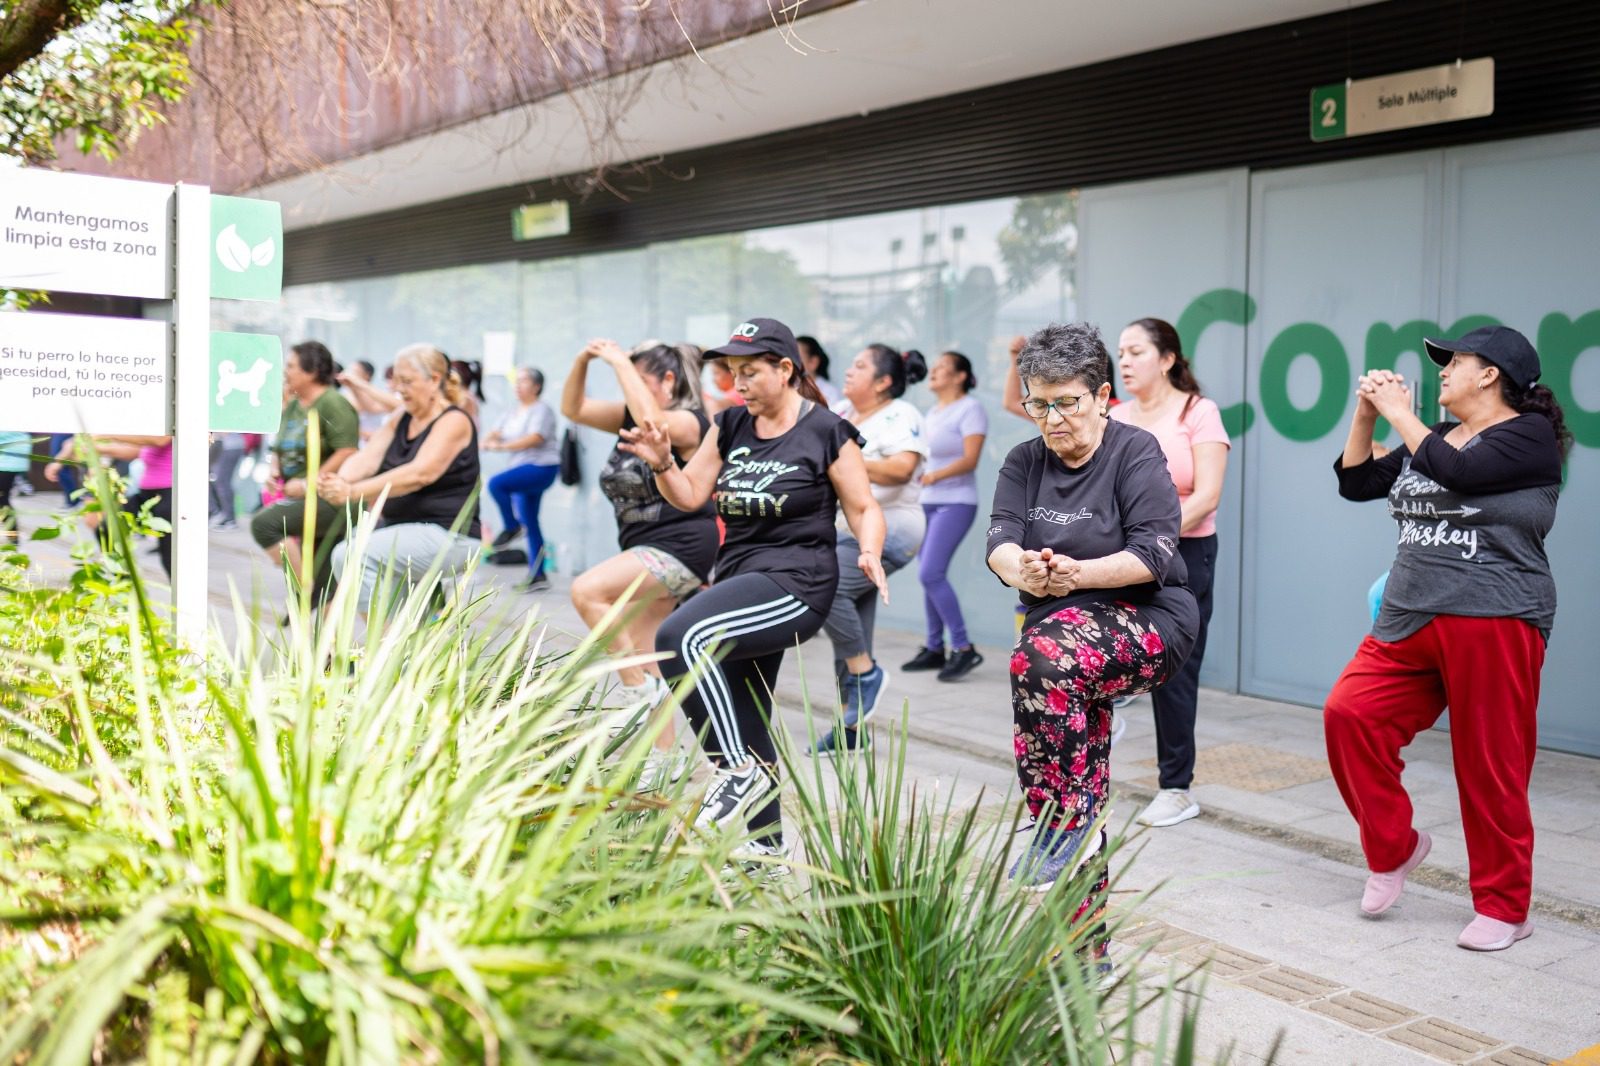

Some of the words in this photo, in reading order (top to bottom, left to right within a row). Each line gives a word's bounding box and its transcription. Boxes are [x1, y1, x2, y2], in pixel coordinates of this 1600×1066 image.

[1407, 86, 1458, 104] Múltiple
[1321, 98, 1338, 128] 2
[14, 205, 149, 233] Mantengamos
[5, 227, 63, 250] limpia
[68, 235, 107, 251] esta
[113, 242, 157, 257] zona
[1, 347, 14, 359] Si
[19, 349, 32, 360] tu
[37, 351, 75, 363] perro
[79, 351, 91, 363] lo
[96, 352, 129, 365] hace
[133, 356, 156, 368] por
[76, 369, 89, 380] tú
[94, 369, 106, 381] lo
[110, 373, 163, 386] recoges
[32, 386, 56, 398] por
[60, 385, 132, 399] educación
[717, 447, 799, 492] Sorry
